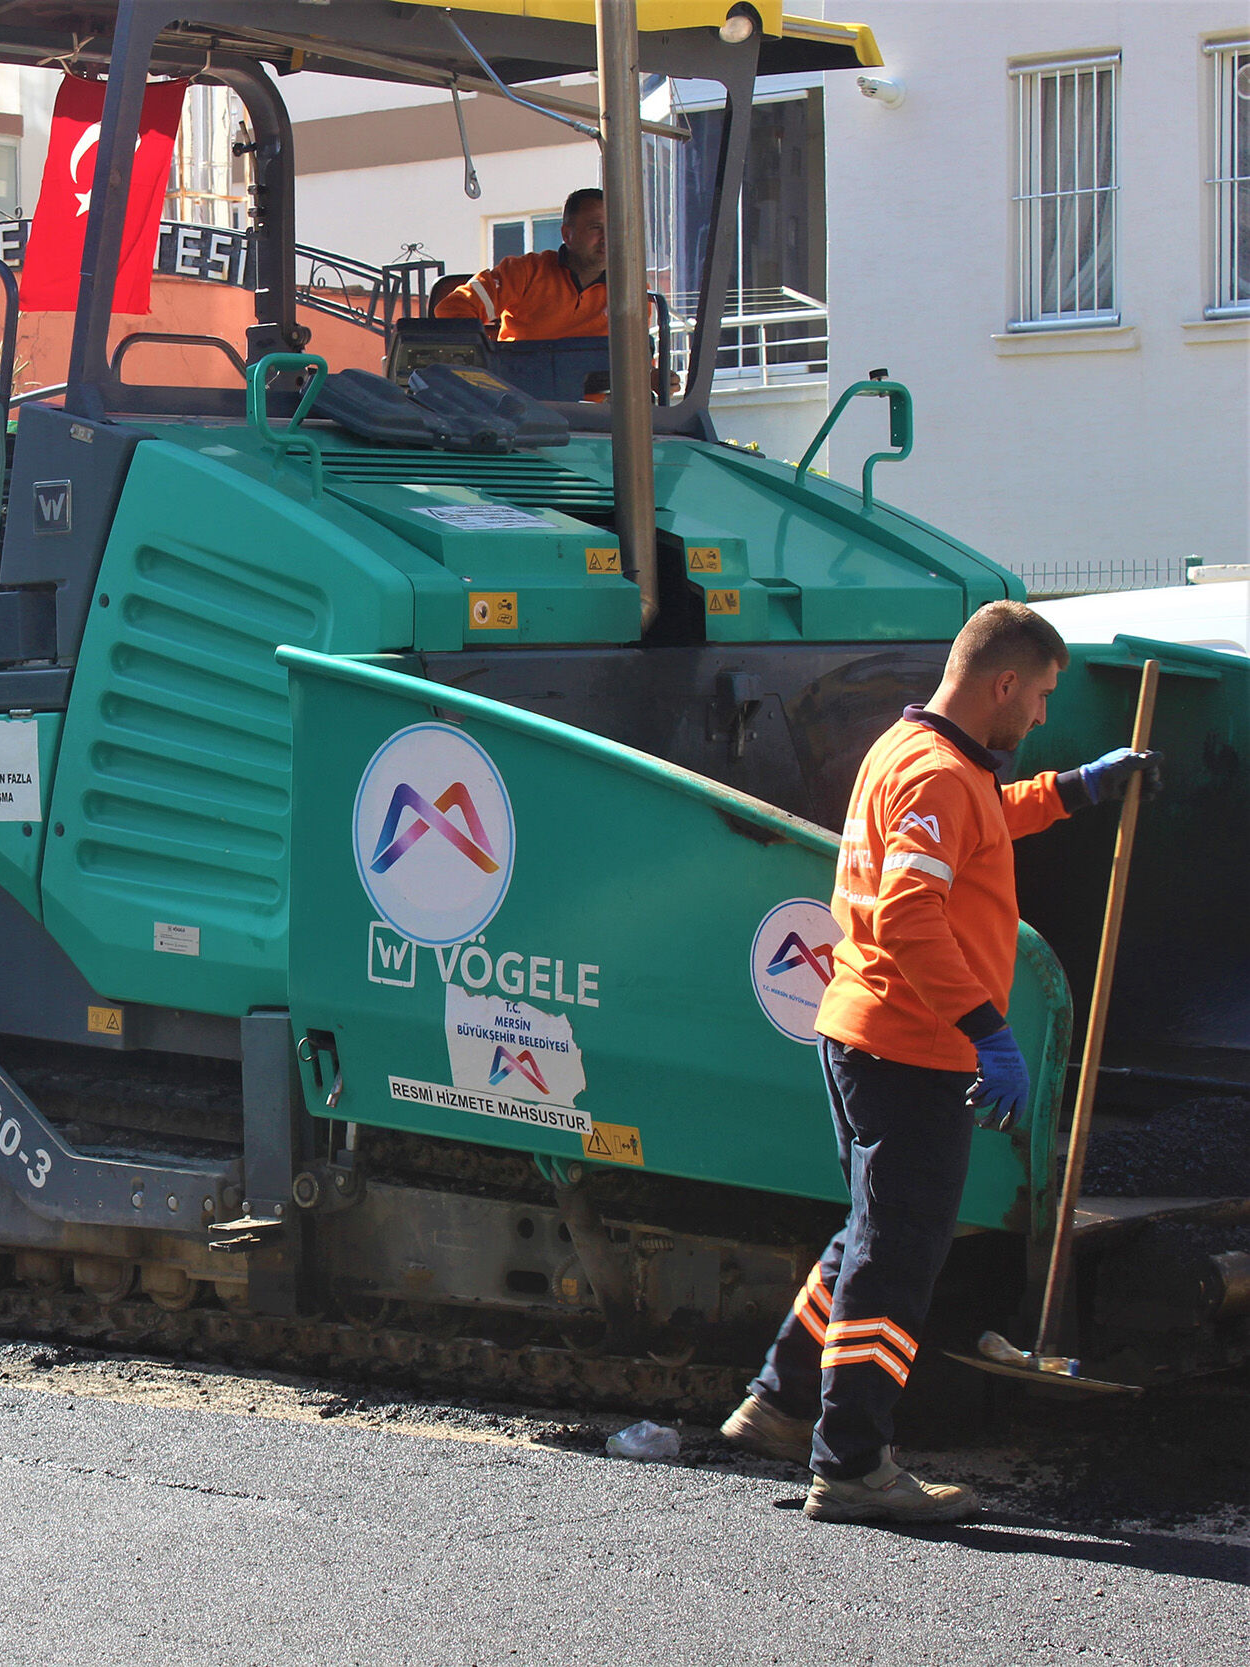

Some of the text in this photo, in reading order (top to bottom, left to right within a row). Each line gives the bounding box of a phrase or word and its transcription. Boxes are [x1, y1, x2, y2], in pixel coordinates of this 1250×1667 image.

[38, 493, 66, 521] W
[7, 774, 32, 784] FAZLA
[376, 934, 600, 1008] W VÖGELE
[505, 1002, 521, 1014] T.C.
[494, 1016, 531, 1031] MERSİN
[457, 1023, 569, 1053] BÜYÜKŞEHİR BELEDİYESİ
[392, 1082, 590, 1132] RESMİ HİZMETE MAHSUSTUR.
